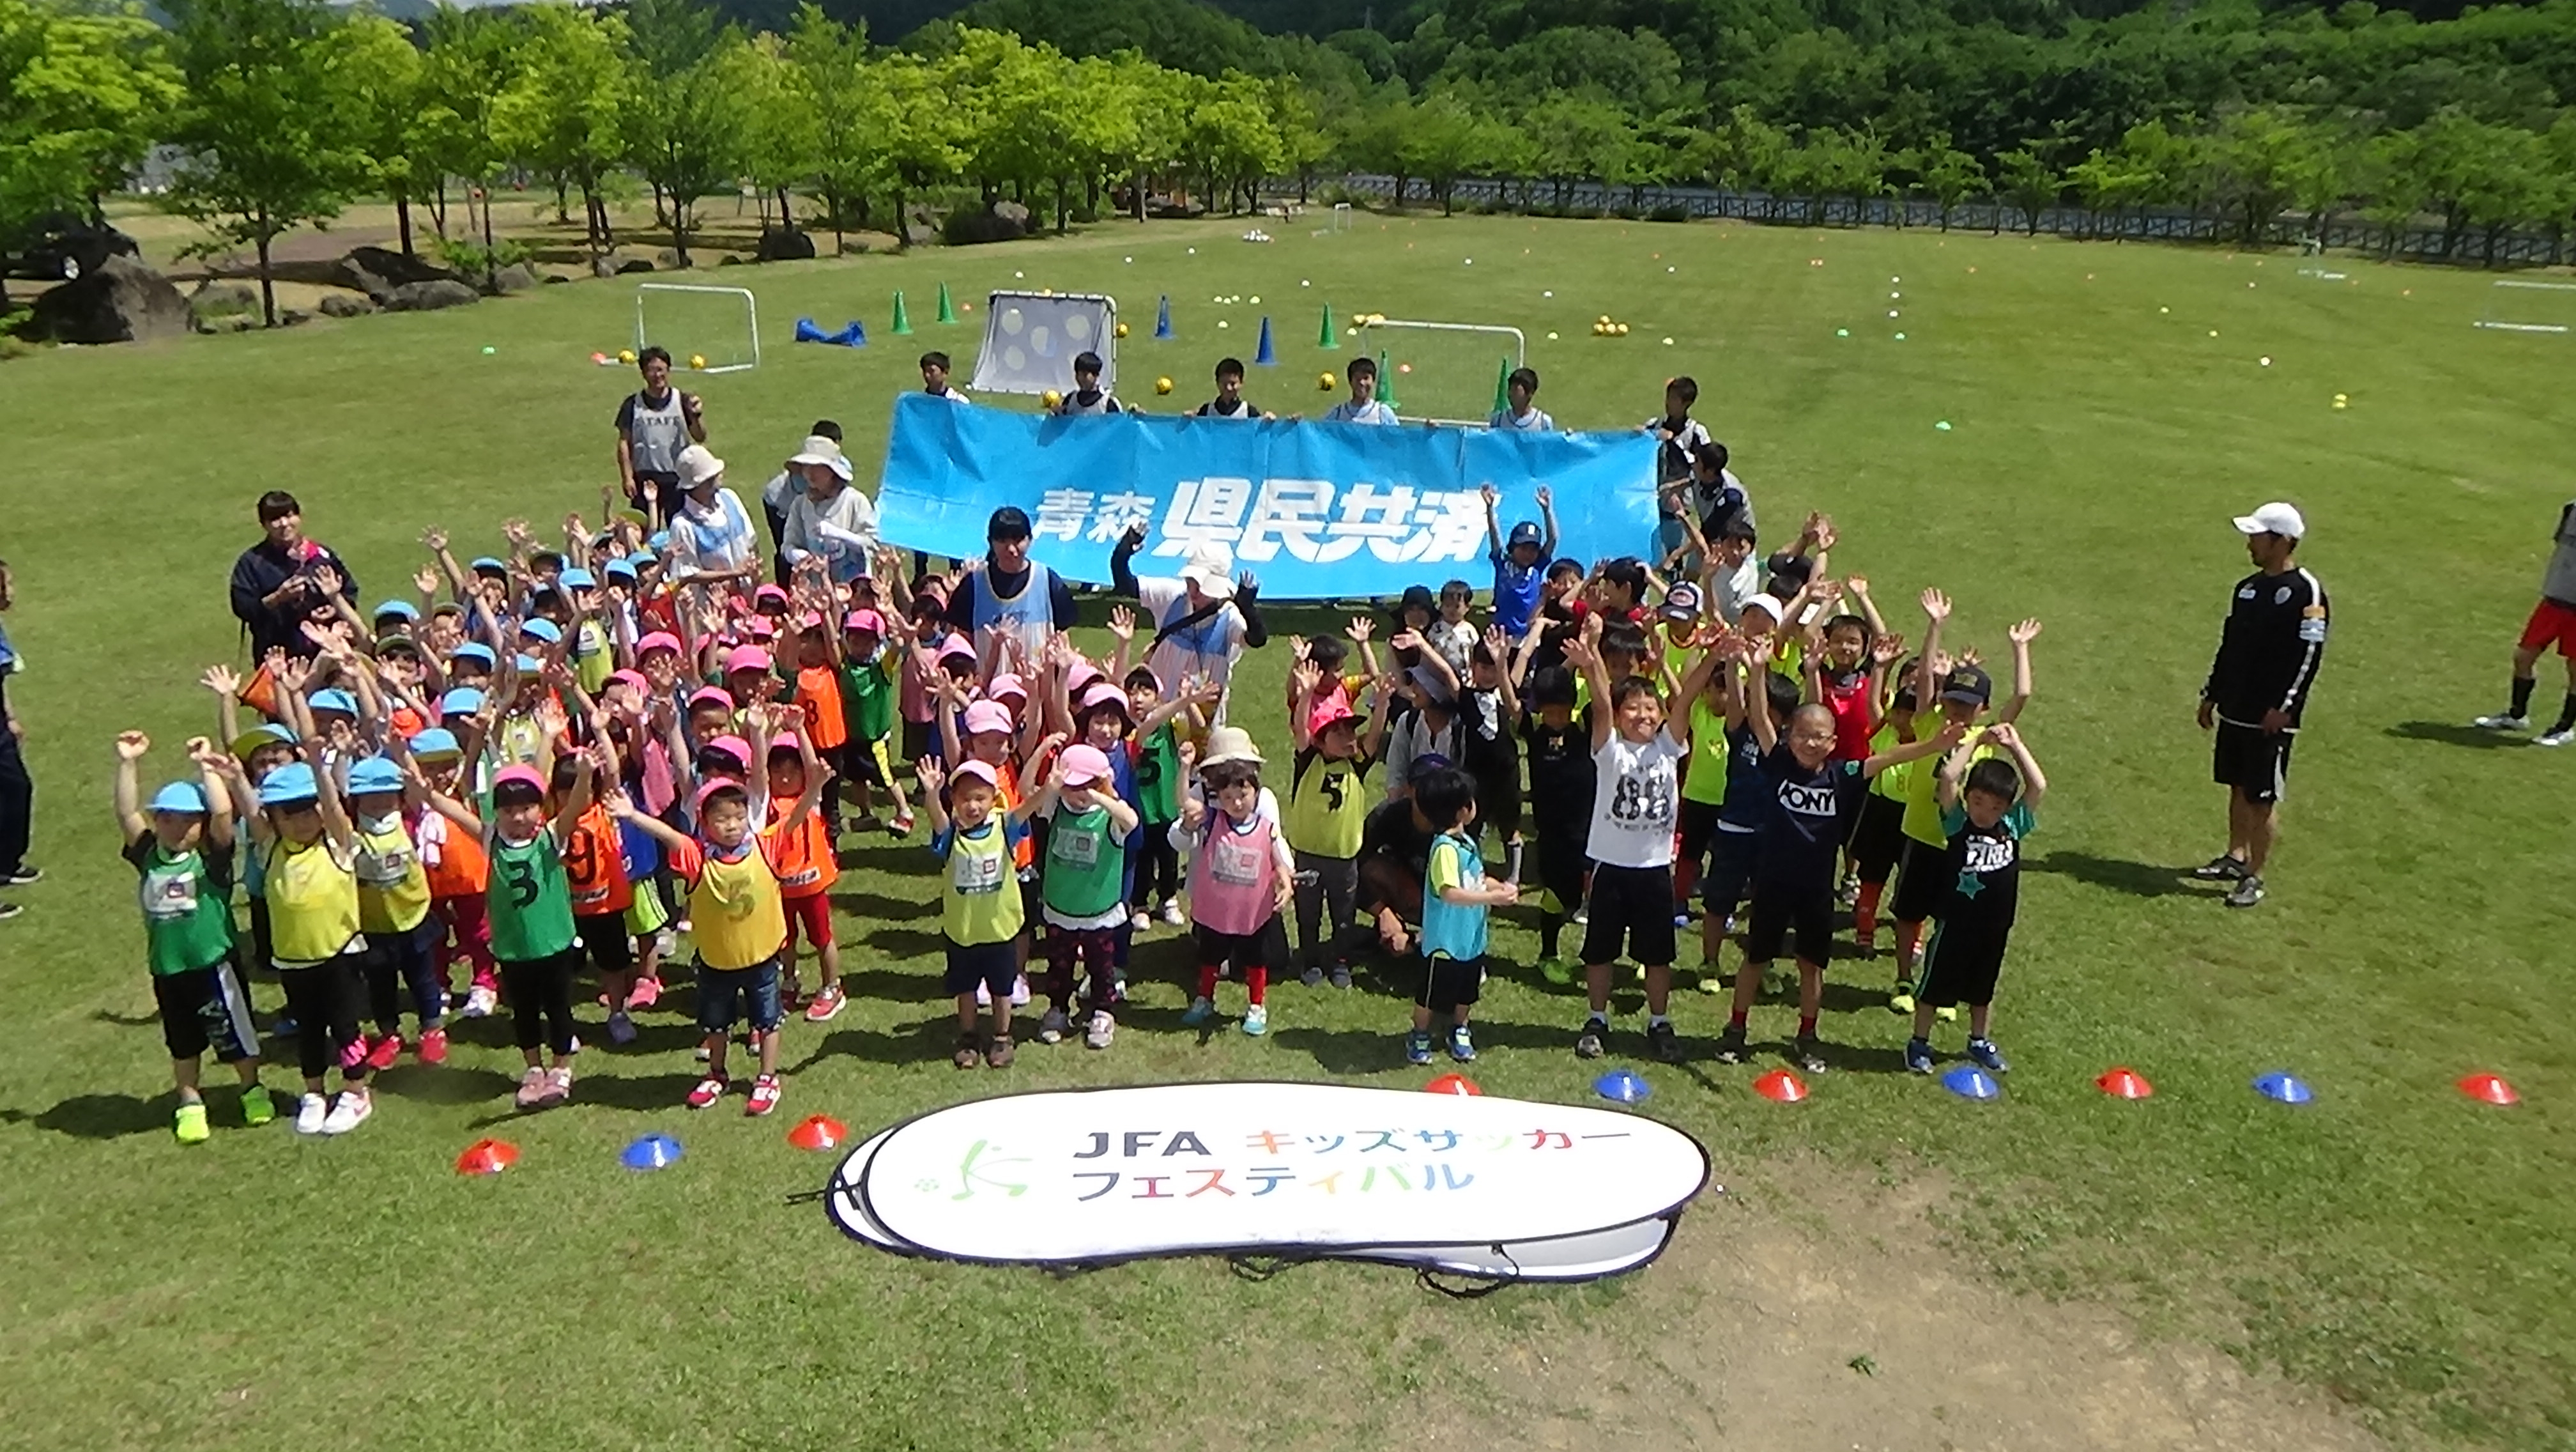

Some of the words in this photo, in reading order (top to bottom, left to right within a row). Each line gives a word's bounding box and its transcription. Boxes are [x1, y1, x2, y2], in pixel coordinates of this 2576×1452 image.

[1031, 487, 1156, 543] 青森
[1150, 476, 1503, 563] 県民共済
[1137, 747, 1162, 786] 5
[1321, 772, 1344, 813] 5
[508, 861, 539, 909] 3
[1073, 1131, 1212, 1158] JFA
[1246, 1128, 1631, 1155] キッズサッカー
[1073, 1162, 1475, 1201] フェスティバル
